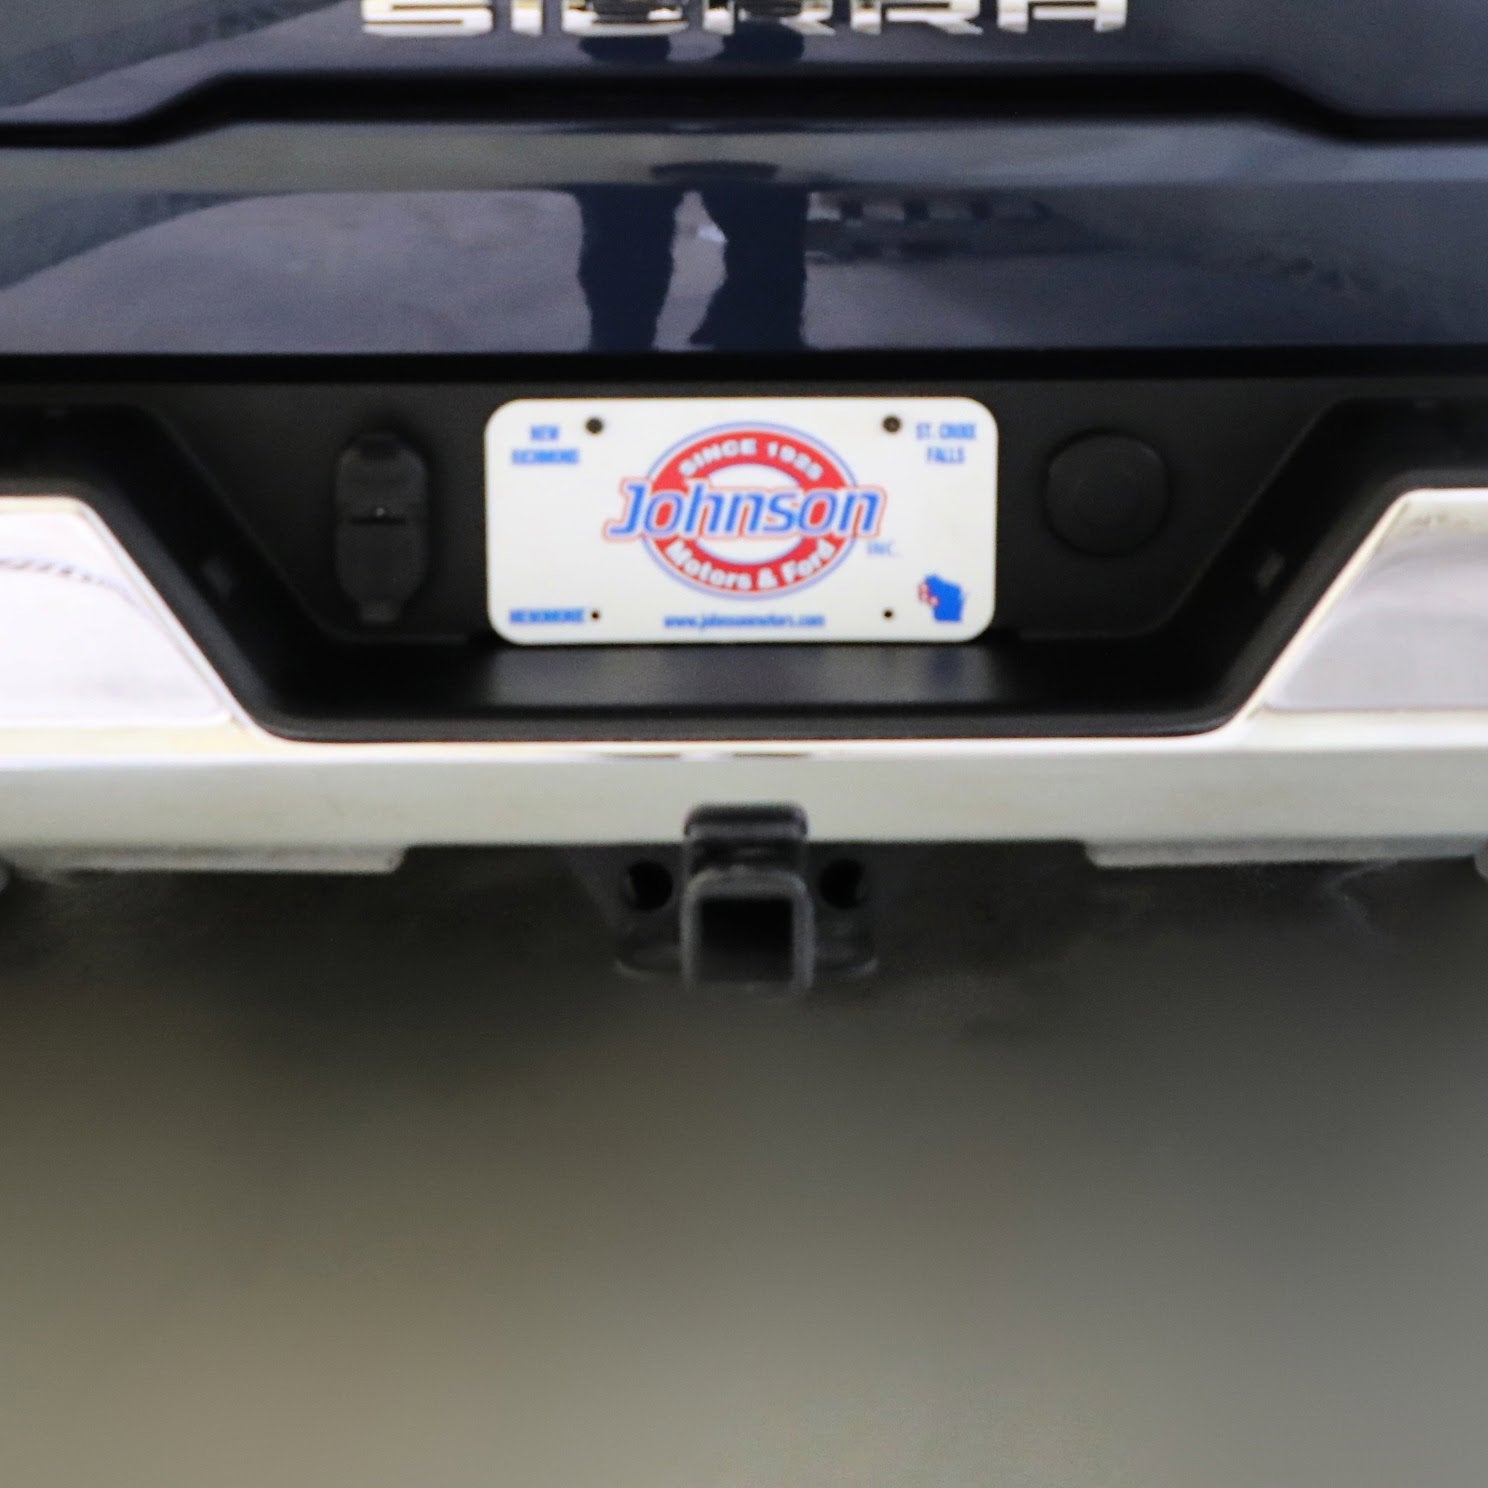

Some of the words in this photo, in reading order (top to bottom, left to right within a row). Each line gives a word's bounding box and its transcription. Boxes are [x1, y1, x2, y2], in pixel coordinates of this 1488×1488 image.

[678, 438, 757, 477] SINCE
[607, 481, 883, 539] Johnson
[664, 539, 753, 590] Motors
[757, 567, 779, 589] &
[779, 539, 837, 584] Ford
